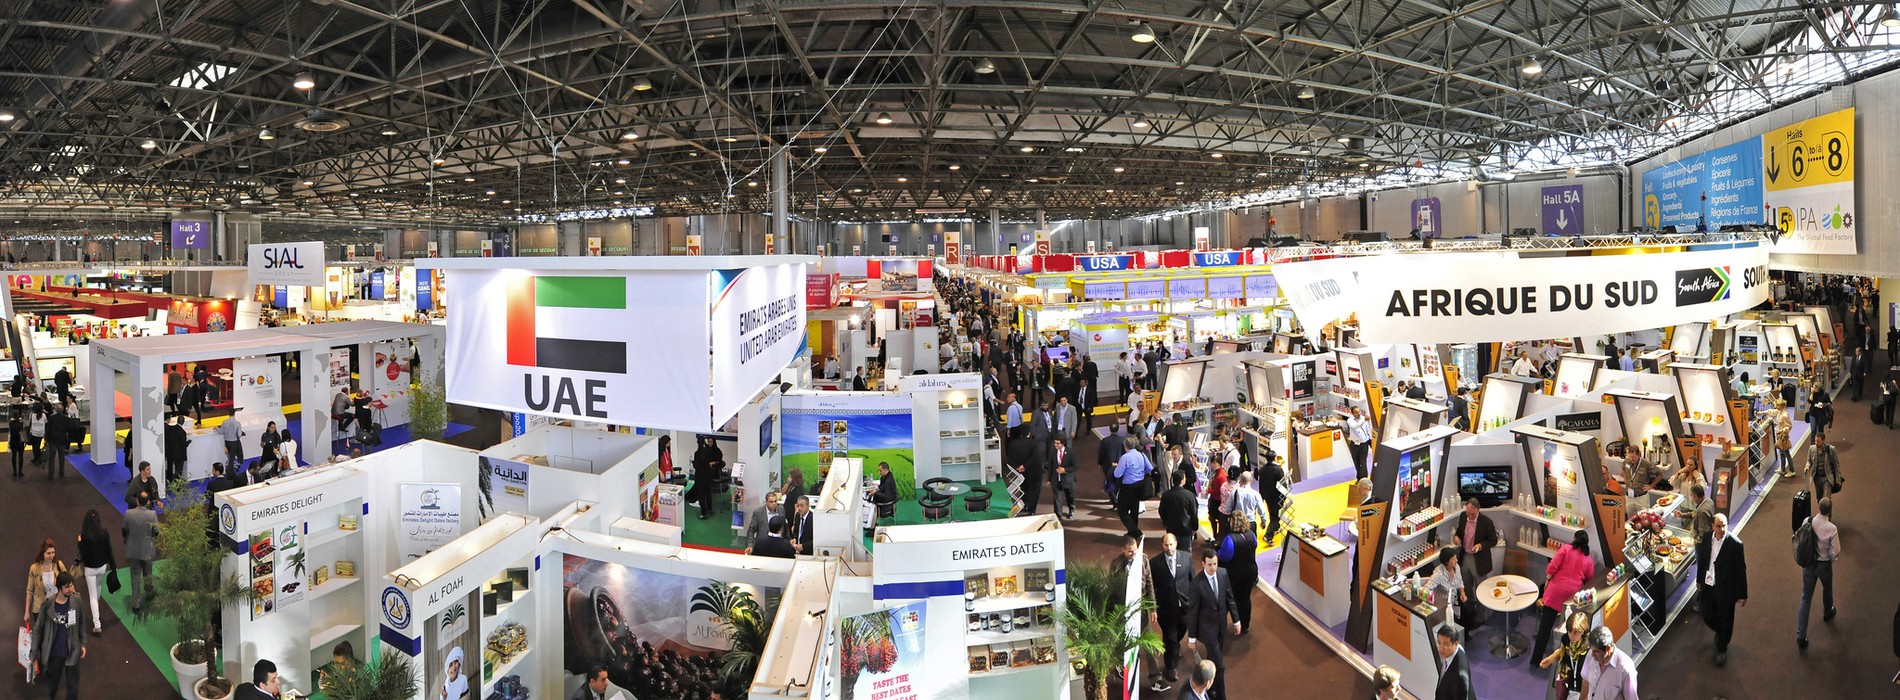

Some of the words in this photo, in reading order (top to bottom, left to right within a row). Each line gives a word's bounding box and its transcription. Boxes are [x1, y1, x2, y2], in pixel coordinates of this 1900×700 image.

[1787, 129, 1802, 140] Halls
[1711, 153, 1738, 166] Conserves
[1792, 146, 1804, 177] 6
[1828, 137, 1843, 171] 8
[1644, 182, 1652, 192] Hall
[1711, 182, 1725, 192] Fruits
[1731, 177, 1755, 191] Légumes
[1543, 194, 1561, 204] Hall
[1563, 190, 1580, 203] 5A
[1733, 206, 1739, 215] de
[1740, 204, 1759, 215] France
[1796, 207, 1818, 231] IPA
[179, 224, 193, 232] Hall
[194, 222, 201, 232] 3
[1835, 233, 1853, 241] Factory
[947, 246, 957, 258] R
[1038, 244, 1048, 256] S
[264, 247, 304, 269] SIAL
[1090, 257, 1120, 270] USA
[1205, 254, 1231, 265] USA
[1678, 278, 1700, 295] South
[1701, 275, 1720, 292] Africa
[1385, 286, 1537, 317] AFRIQUE
[1550, 283, 1593, 312] DU
[1605, 280, 1658, 308] SUD
[740, 304, 767, 336] EMIRATS
[768, 298, 786, 322] ARABES
[787, 294, 797, 313] UNIS
[740, 333, 763, 365] UNITED
[764, 325, 777, 350] ARAB
[778, 314, 797, 340] EMIRATES
[918, 378, 947, 388] aldahra
[524, 373, 608, 419] UAE
[251, 502, 289, 521] EMIRATES
[291, 493, 324, 511] DELIGHT
[952, 545, 1007, 561] EMIRATES
[1010, 542, 1045, 556] DATES
[428, 591, 439, 606] AL
[441, 576, 463, 598] FOAH
[872, 677, 894, 690] TASTE
[895, 674, 909, 684] THE
[871, 690, 889, 700] BEST
[889, 685, 911, 697] DATES
